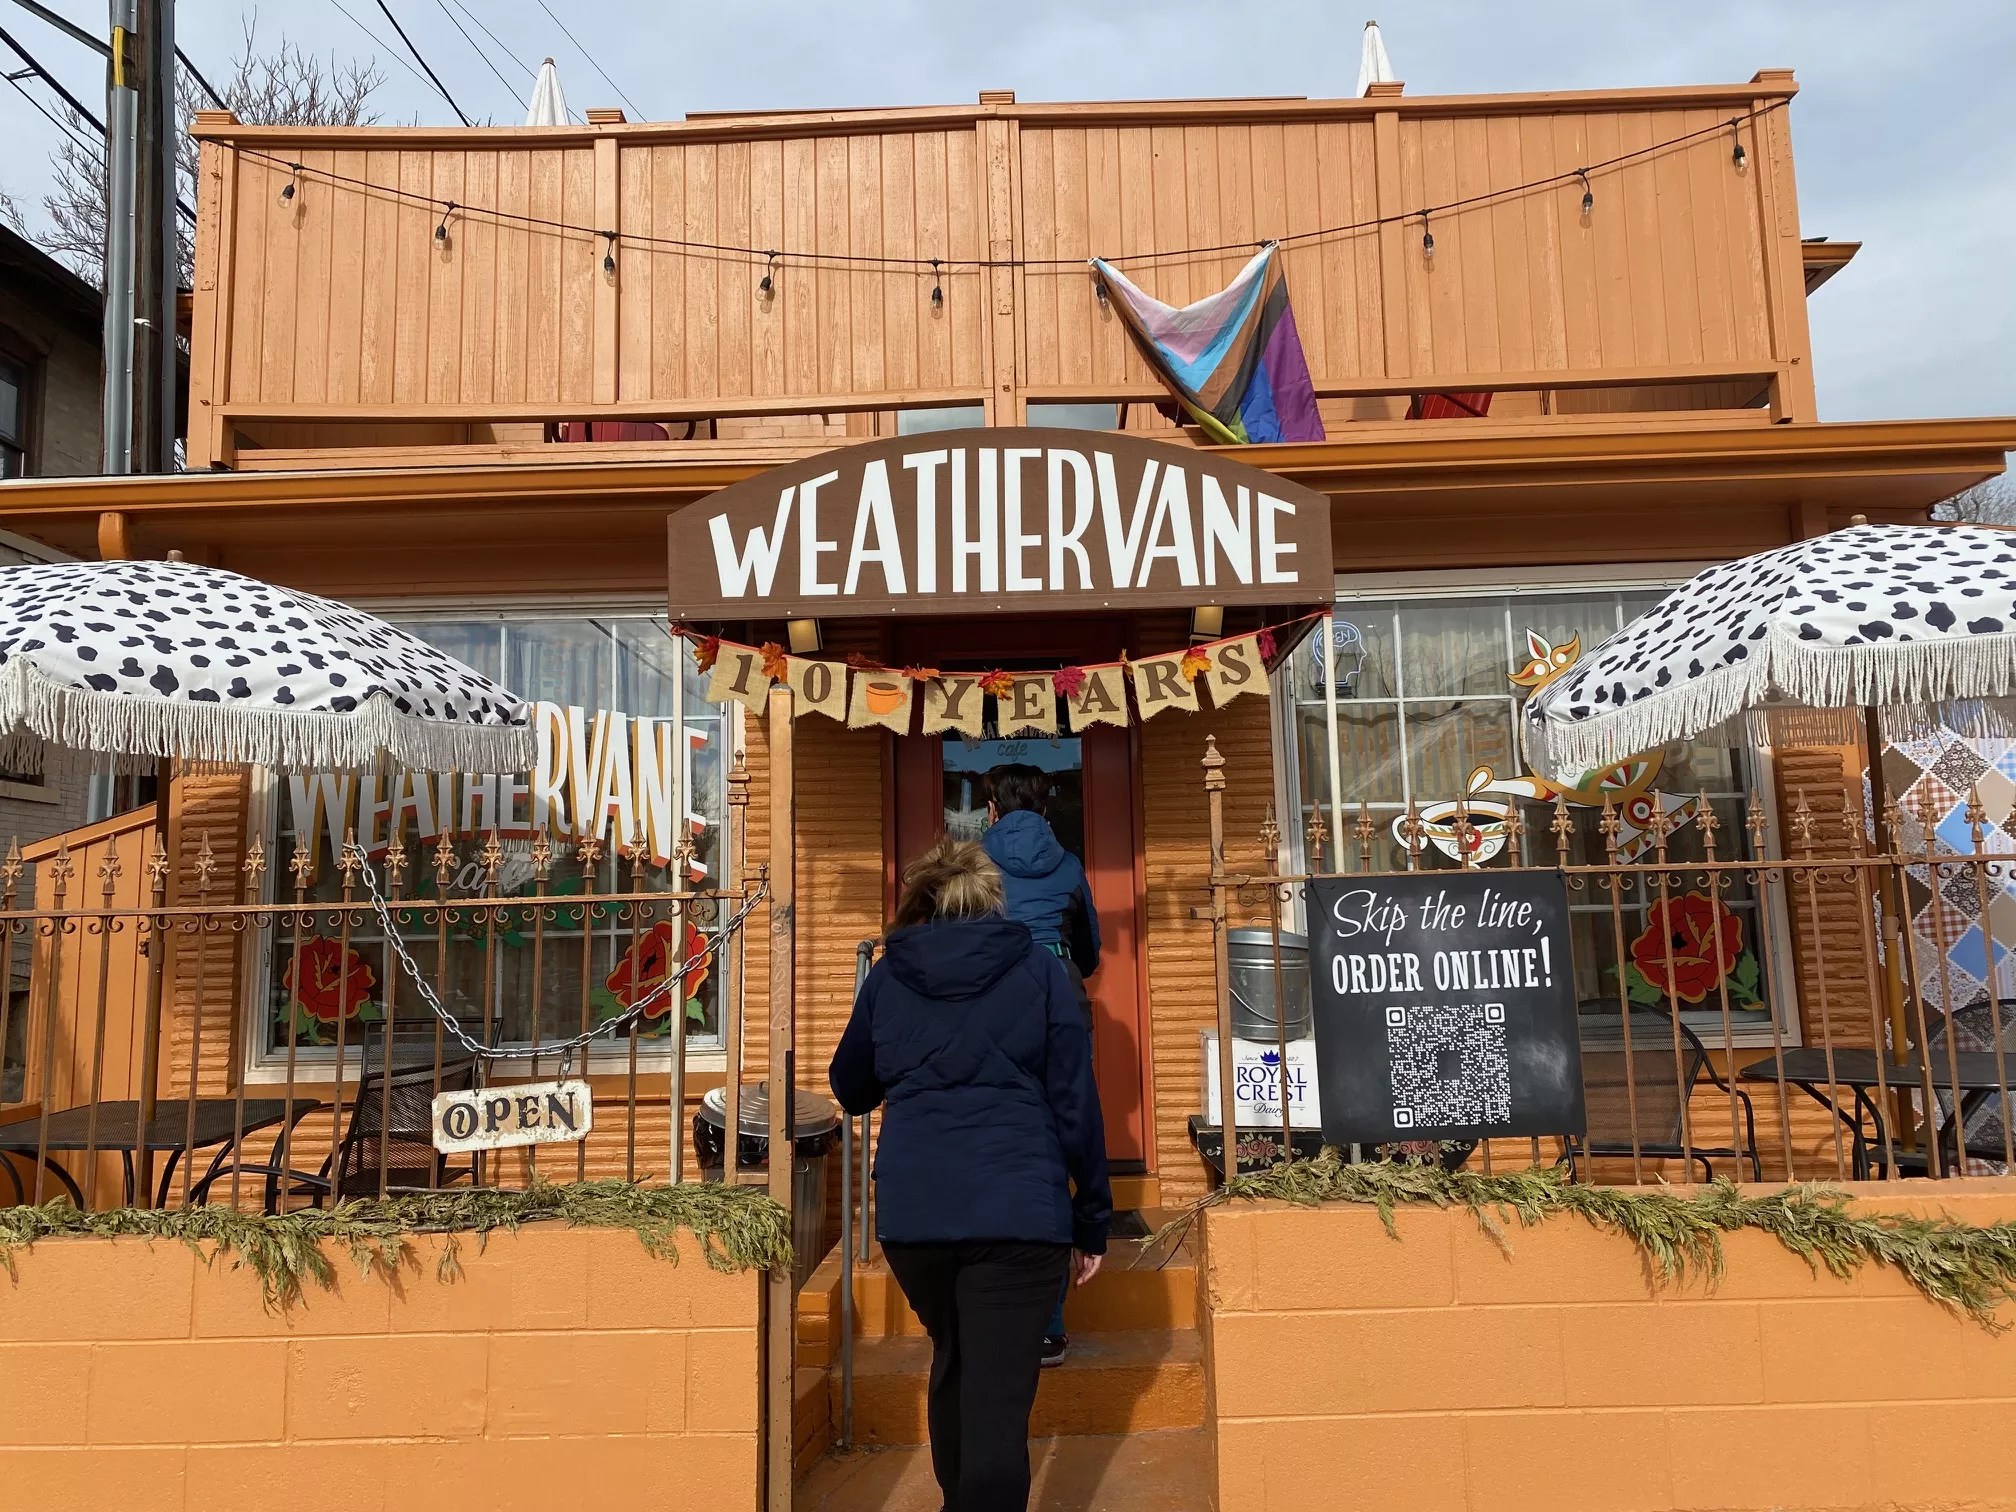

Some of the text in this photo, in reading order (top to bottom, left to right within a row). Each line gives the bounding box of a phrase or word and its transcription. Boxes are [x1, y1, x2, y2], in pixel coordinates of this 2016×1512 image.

[707, 448, 1300, 598] WEATHERVANE
[729, 643, 1252, 721] 10 YEARS
[1333, 888, 1543, 947] Skip the line,
[1332, 936, 1552, 995] ORDER ONLINE!
[1236, 1066, 1308, 1084] ROYAL
[1236, 1084, 1307, 1102] CREST
[442, 1091, 579, 1140] OPEN
